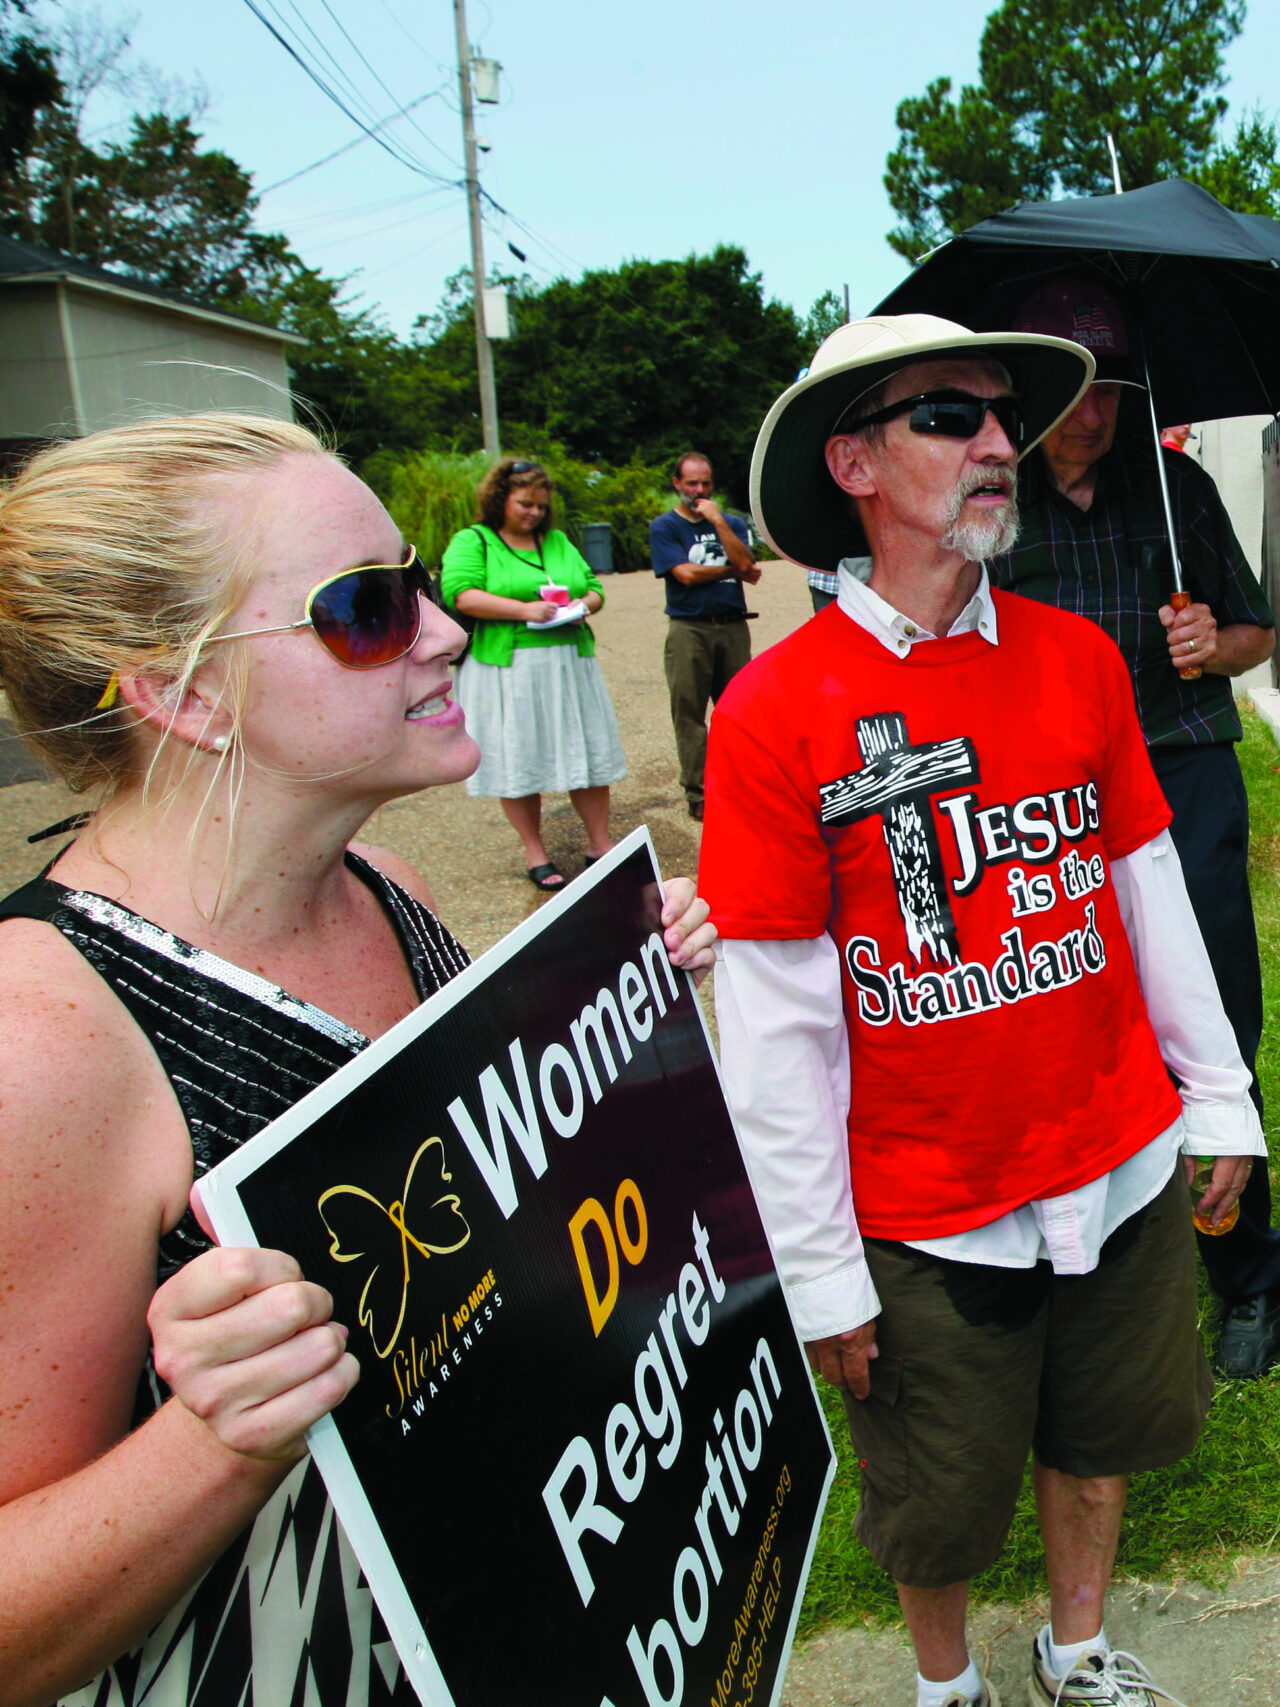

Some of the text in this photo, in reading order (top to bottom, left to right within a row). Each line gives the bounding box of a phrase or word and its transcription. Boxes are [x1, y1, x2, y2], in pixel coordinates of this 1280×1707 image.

[1006, 849, 1105, 918] is the
[846, 900, 1107, 1028] Standard
[447, 931, 680, 1220] Women
[385, 1269, 497, 1419] Silent NO MORE
[401, 1292, 503, 1436] AWARENESS
[542, 1210, 726, 1608] Regret
[600, 1337, 782, 1707] bortion
[735, 1556, 781, 1707] -395-HELP
